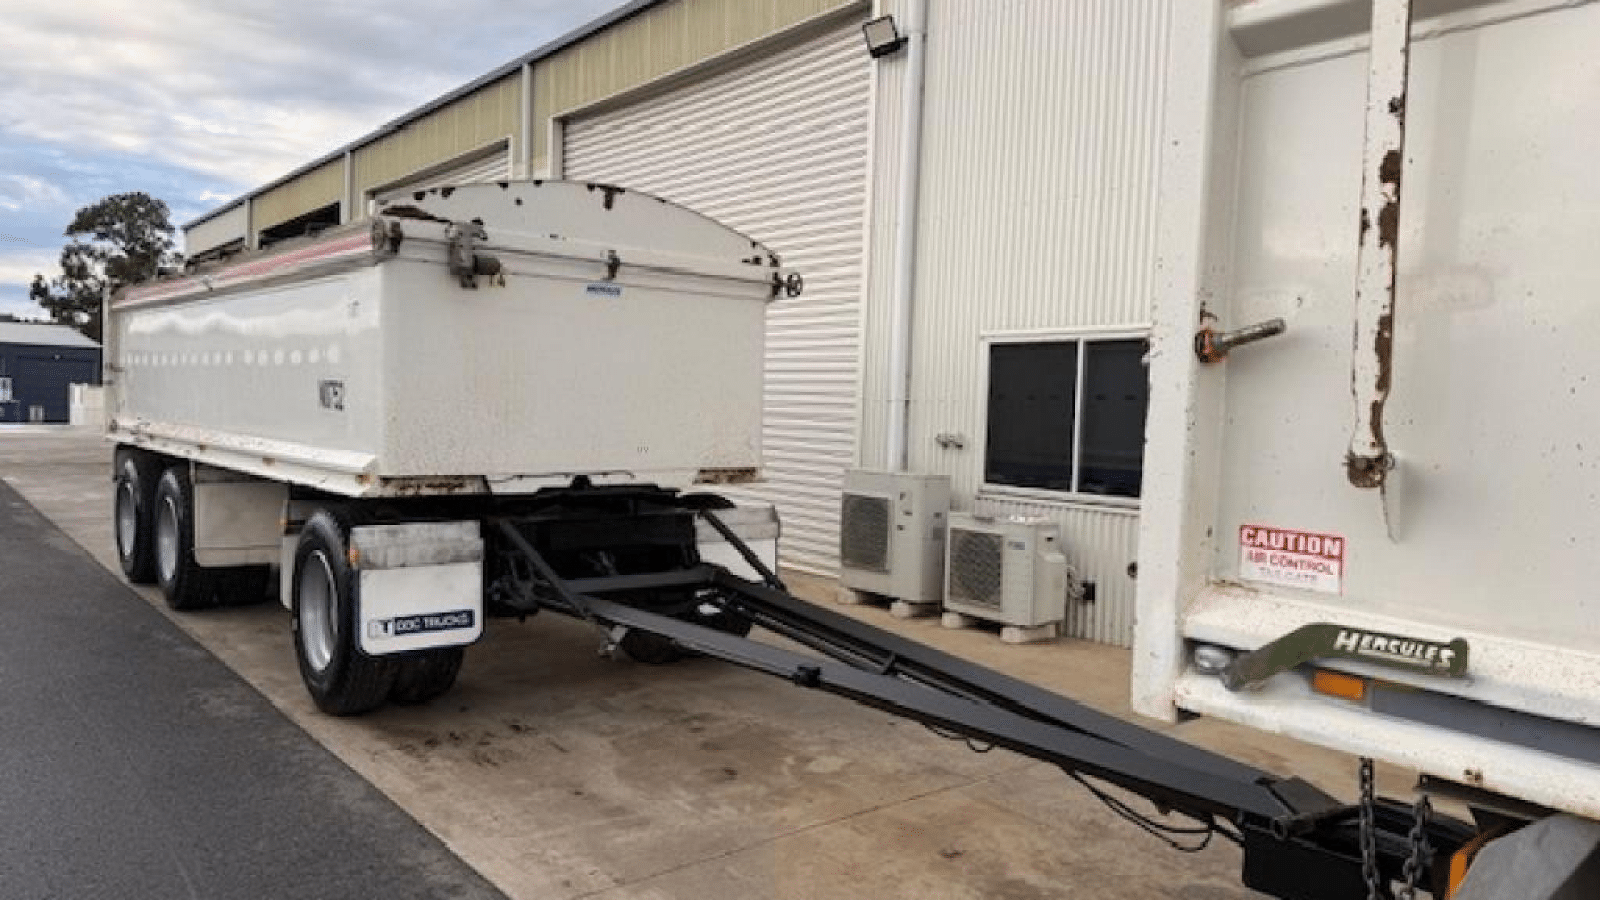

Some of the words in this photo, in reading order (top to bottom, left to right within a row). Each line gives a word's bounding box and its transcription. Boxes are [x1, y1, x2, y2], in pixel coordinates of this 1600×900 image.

[1241, 528, 1341, 558] CAUTION
[1270, 554, 1334, 576] CONTROL
[1333, 630, 1456, 665] HERCULES
